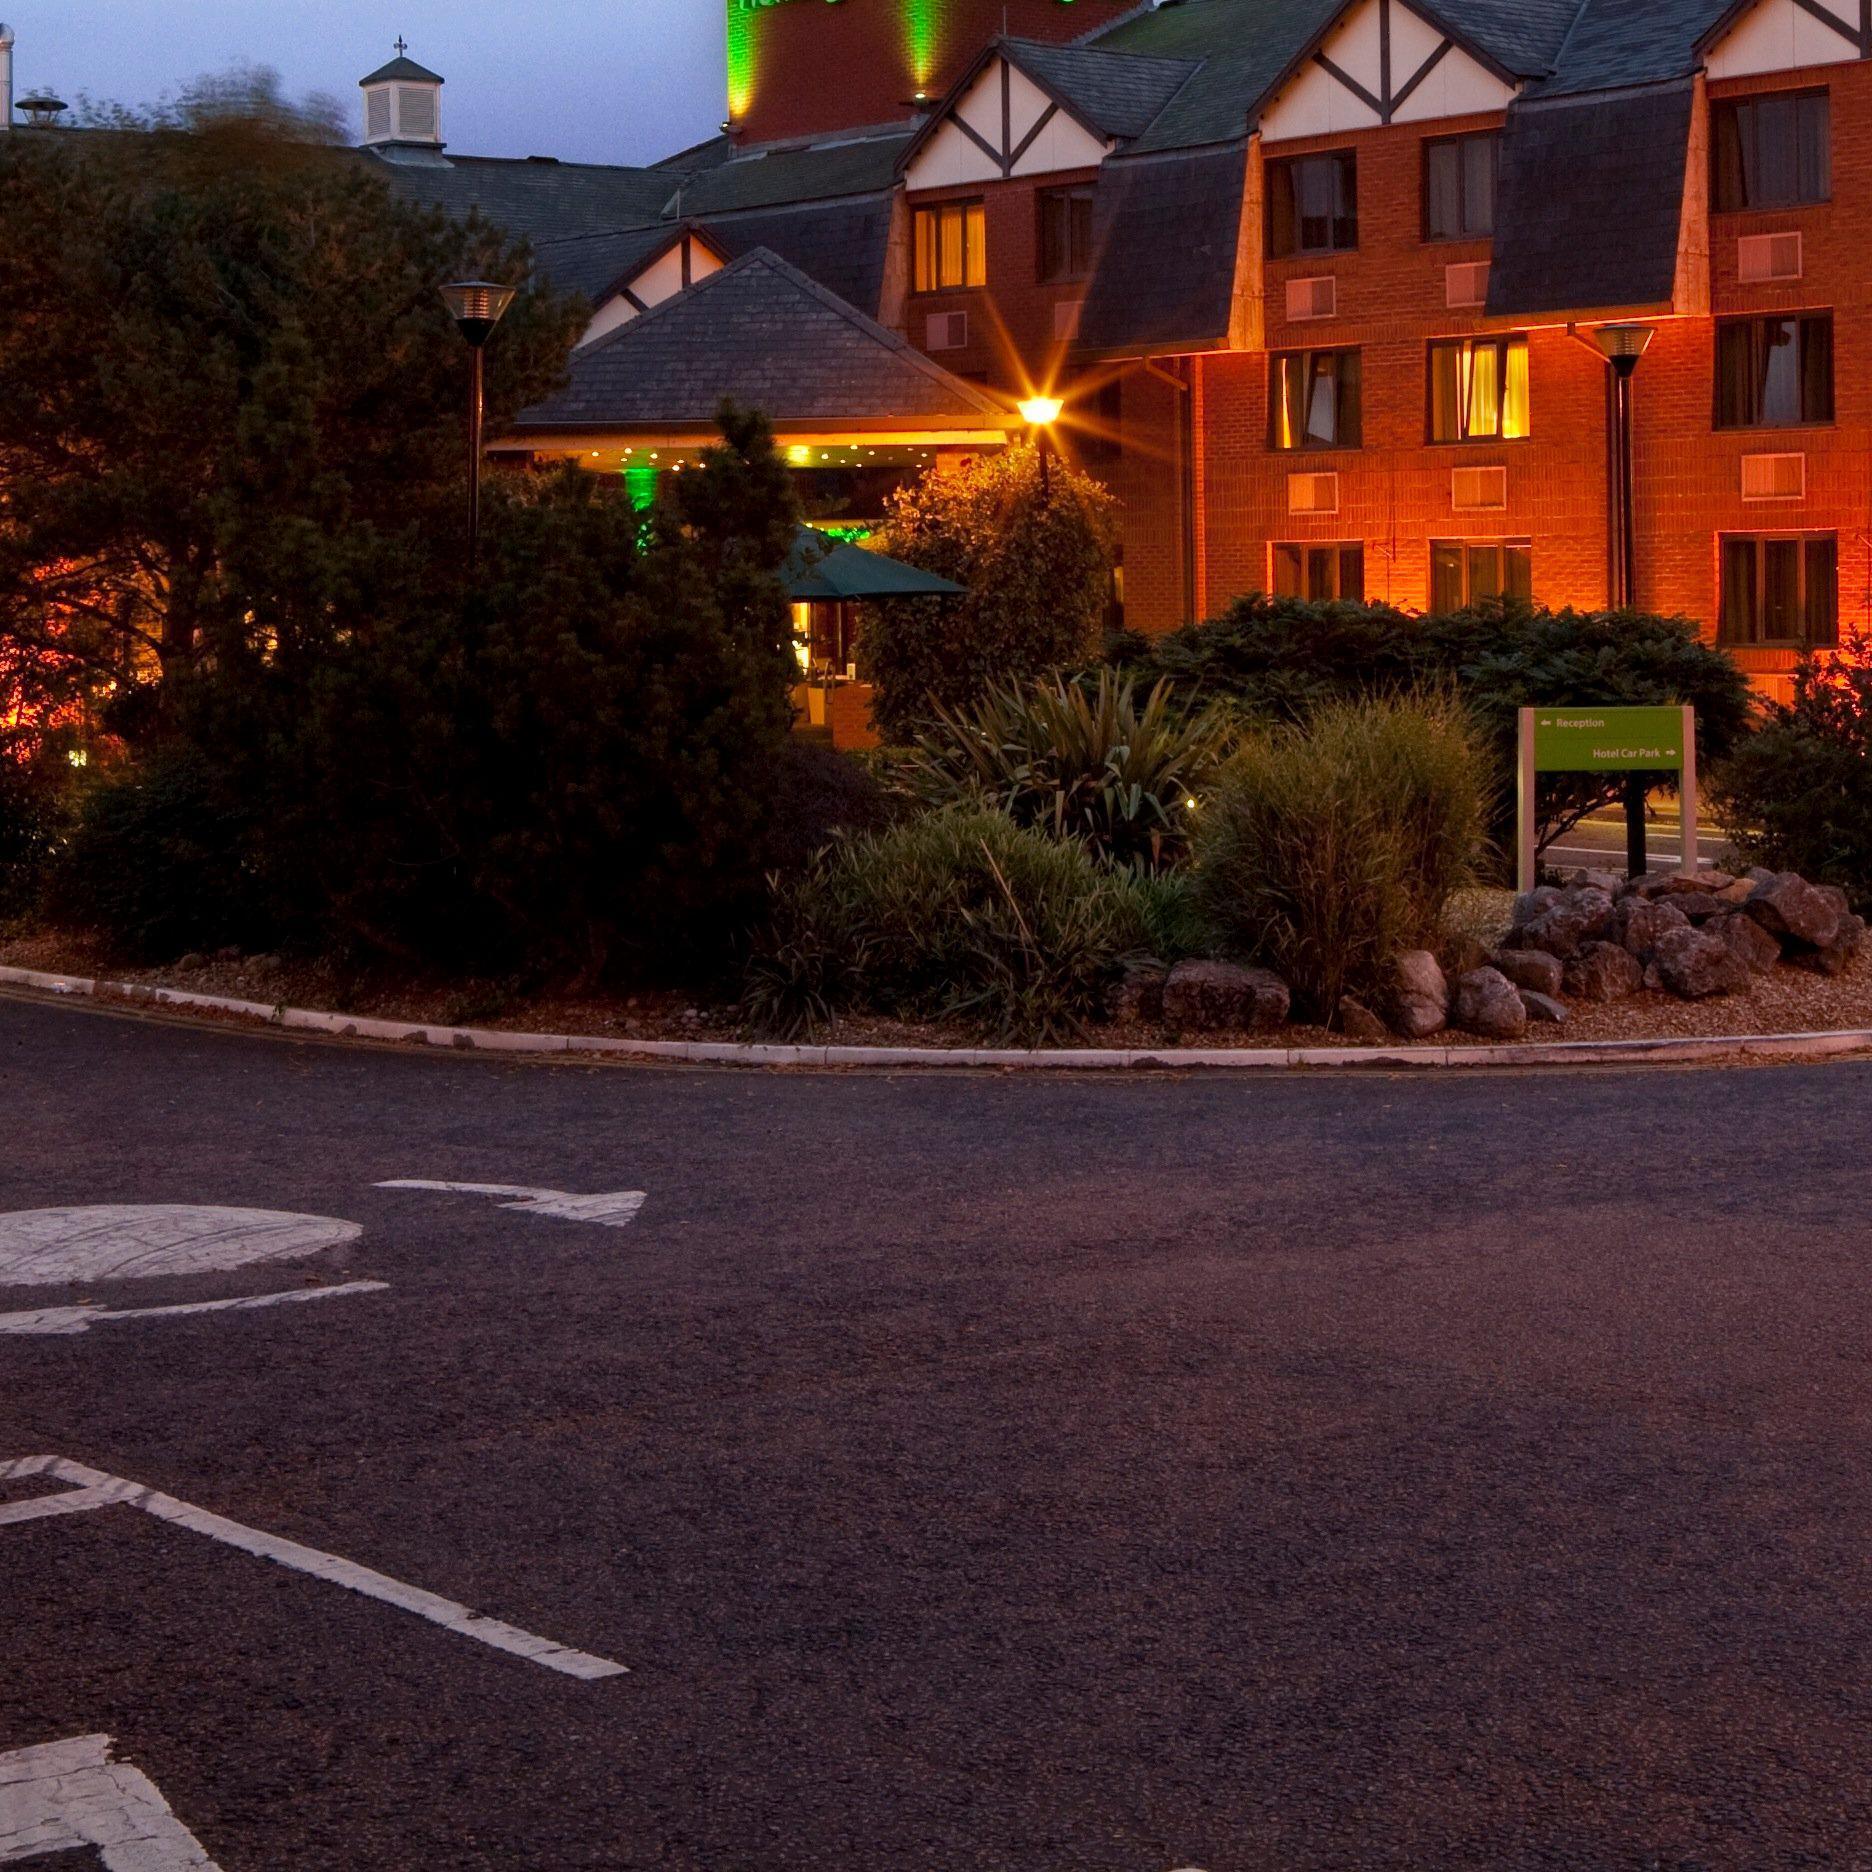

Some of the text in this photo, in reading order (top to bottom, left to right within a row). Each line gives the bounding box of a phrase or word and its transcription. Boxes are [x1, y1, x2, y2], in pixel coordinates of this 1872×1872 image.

[1556, 718, 1605, 729] Reception
[1593, 748, 1661, 758] Hotel Car Park
